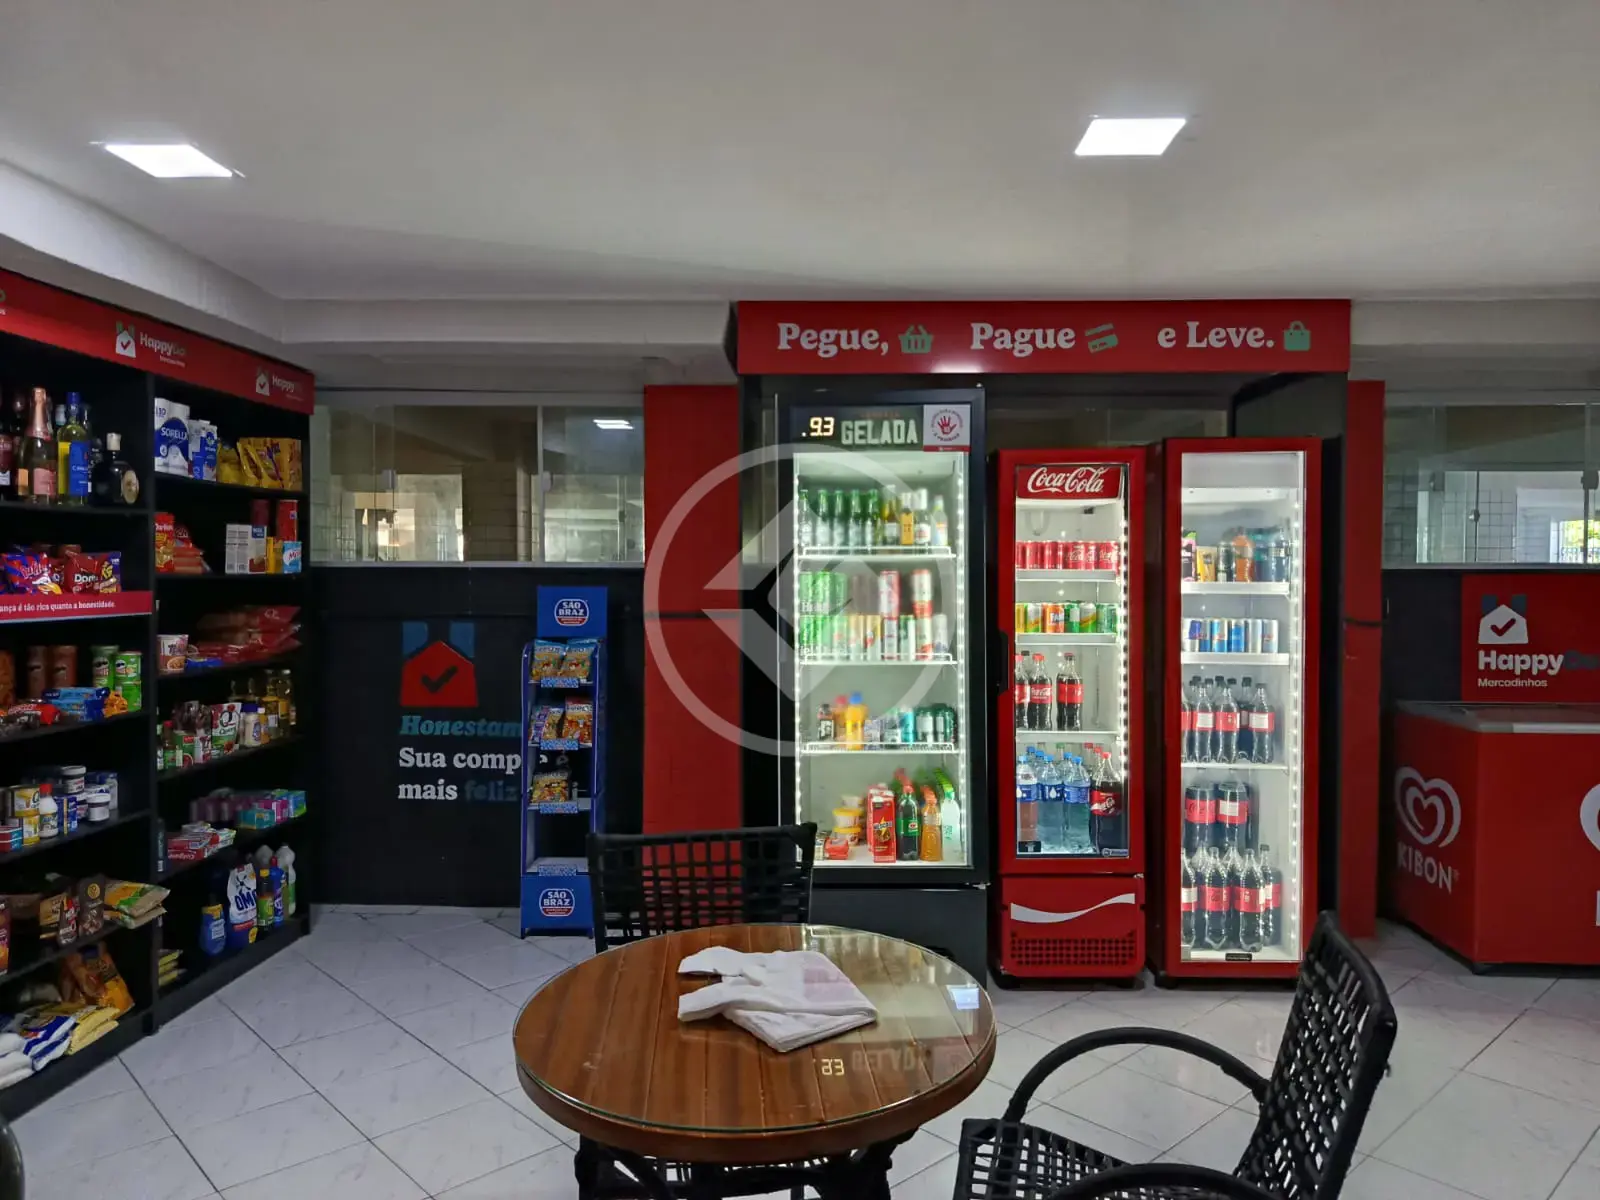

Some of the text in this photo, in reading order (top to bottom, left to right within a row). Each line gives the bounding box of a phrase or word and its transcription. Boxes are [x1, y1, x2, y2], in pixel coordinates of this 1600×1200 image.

[777, 321, 1275, 358] Pegue, Pague e Leve.
[840, 418, 918, 445] GELADA
[1027, 466, 1110, 494] Coca-Cola
[558, 608, 585, 616] BRAZ
[398, 747, 448, 768] Sua
[398, 778, 459, 801] mais
[543, 898, 571, 906] BRAZ
